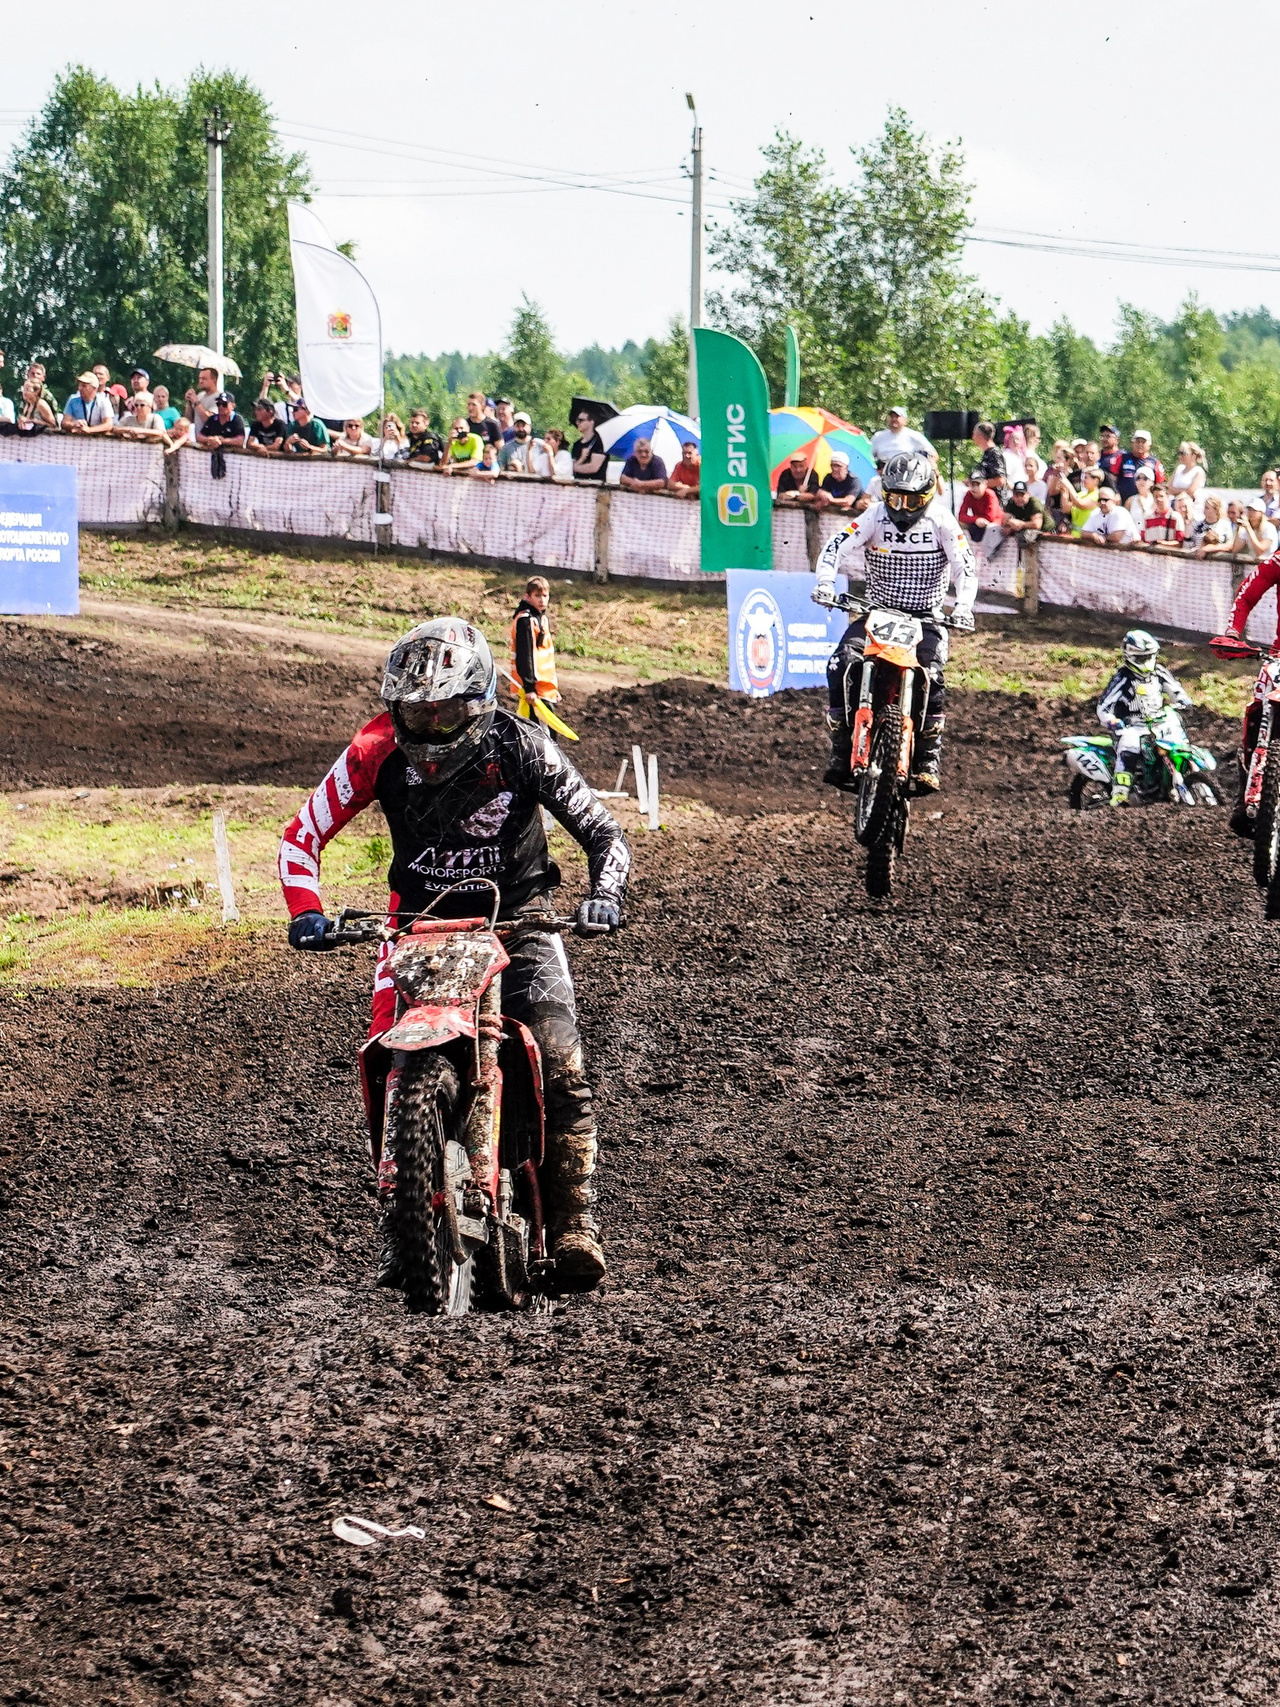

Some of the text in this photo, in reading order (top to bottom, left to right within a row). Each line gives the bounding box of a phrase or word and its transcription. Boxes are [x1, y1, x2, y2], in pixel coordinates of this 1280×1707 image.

[726, 404, 748, 478] 2ГИС
[0, 512, 42, 529] ЕДЕРАЦИЯ
[871, 621, 918, 646] 43
[407, 862, 506, 879] MOTORSPORTS
